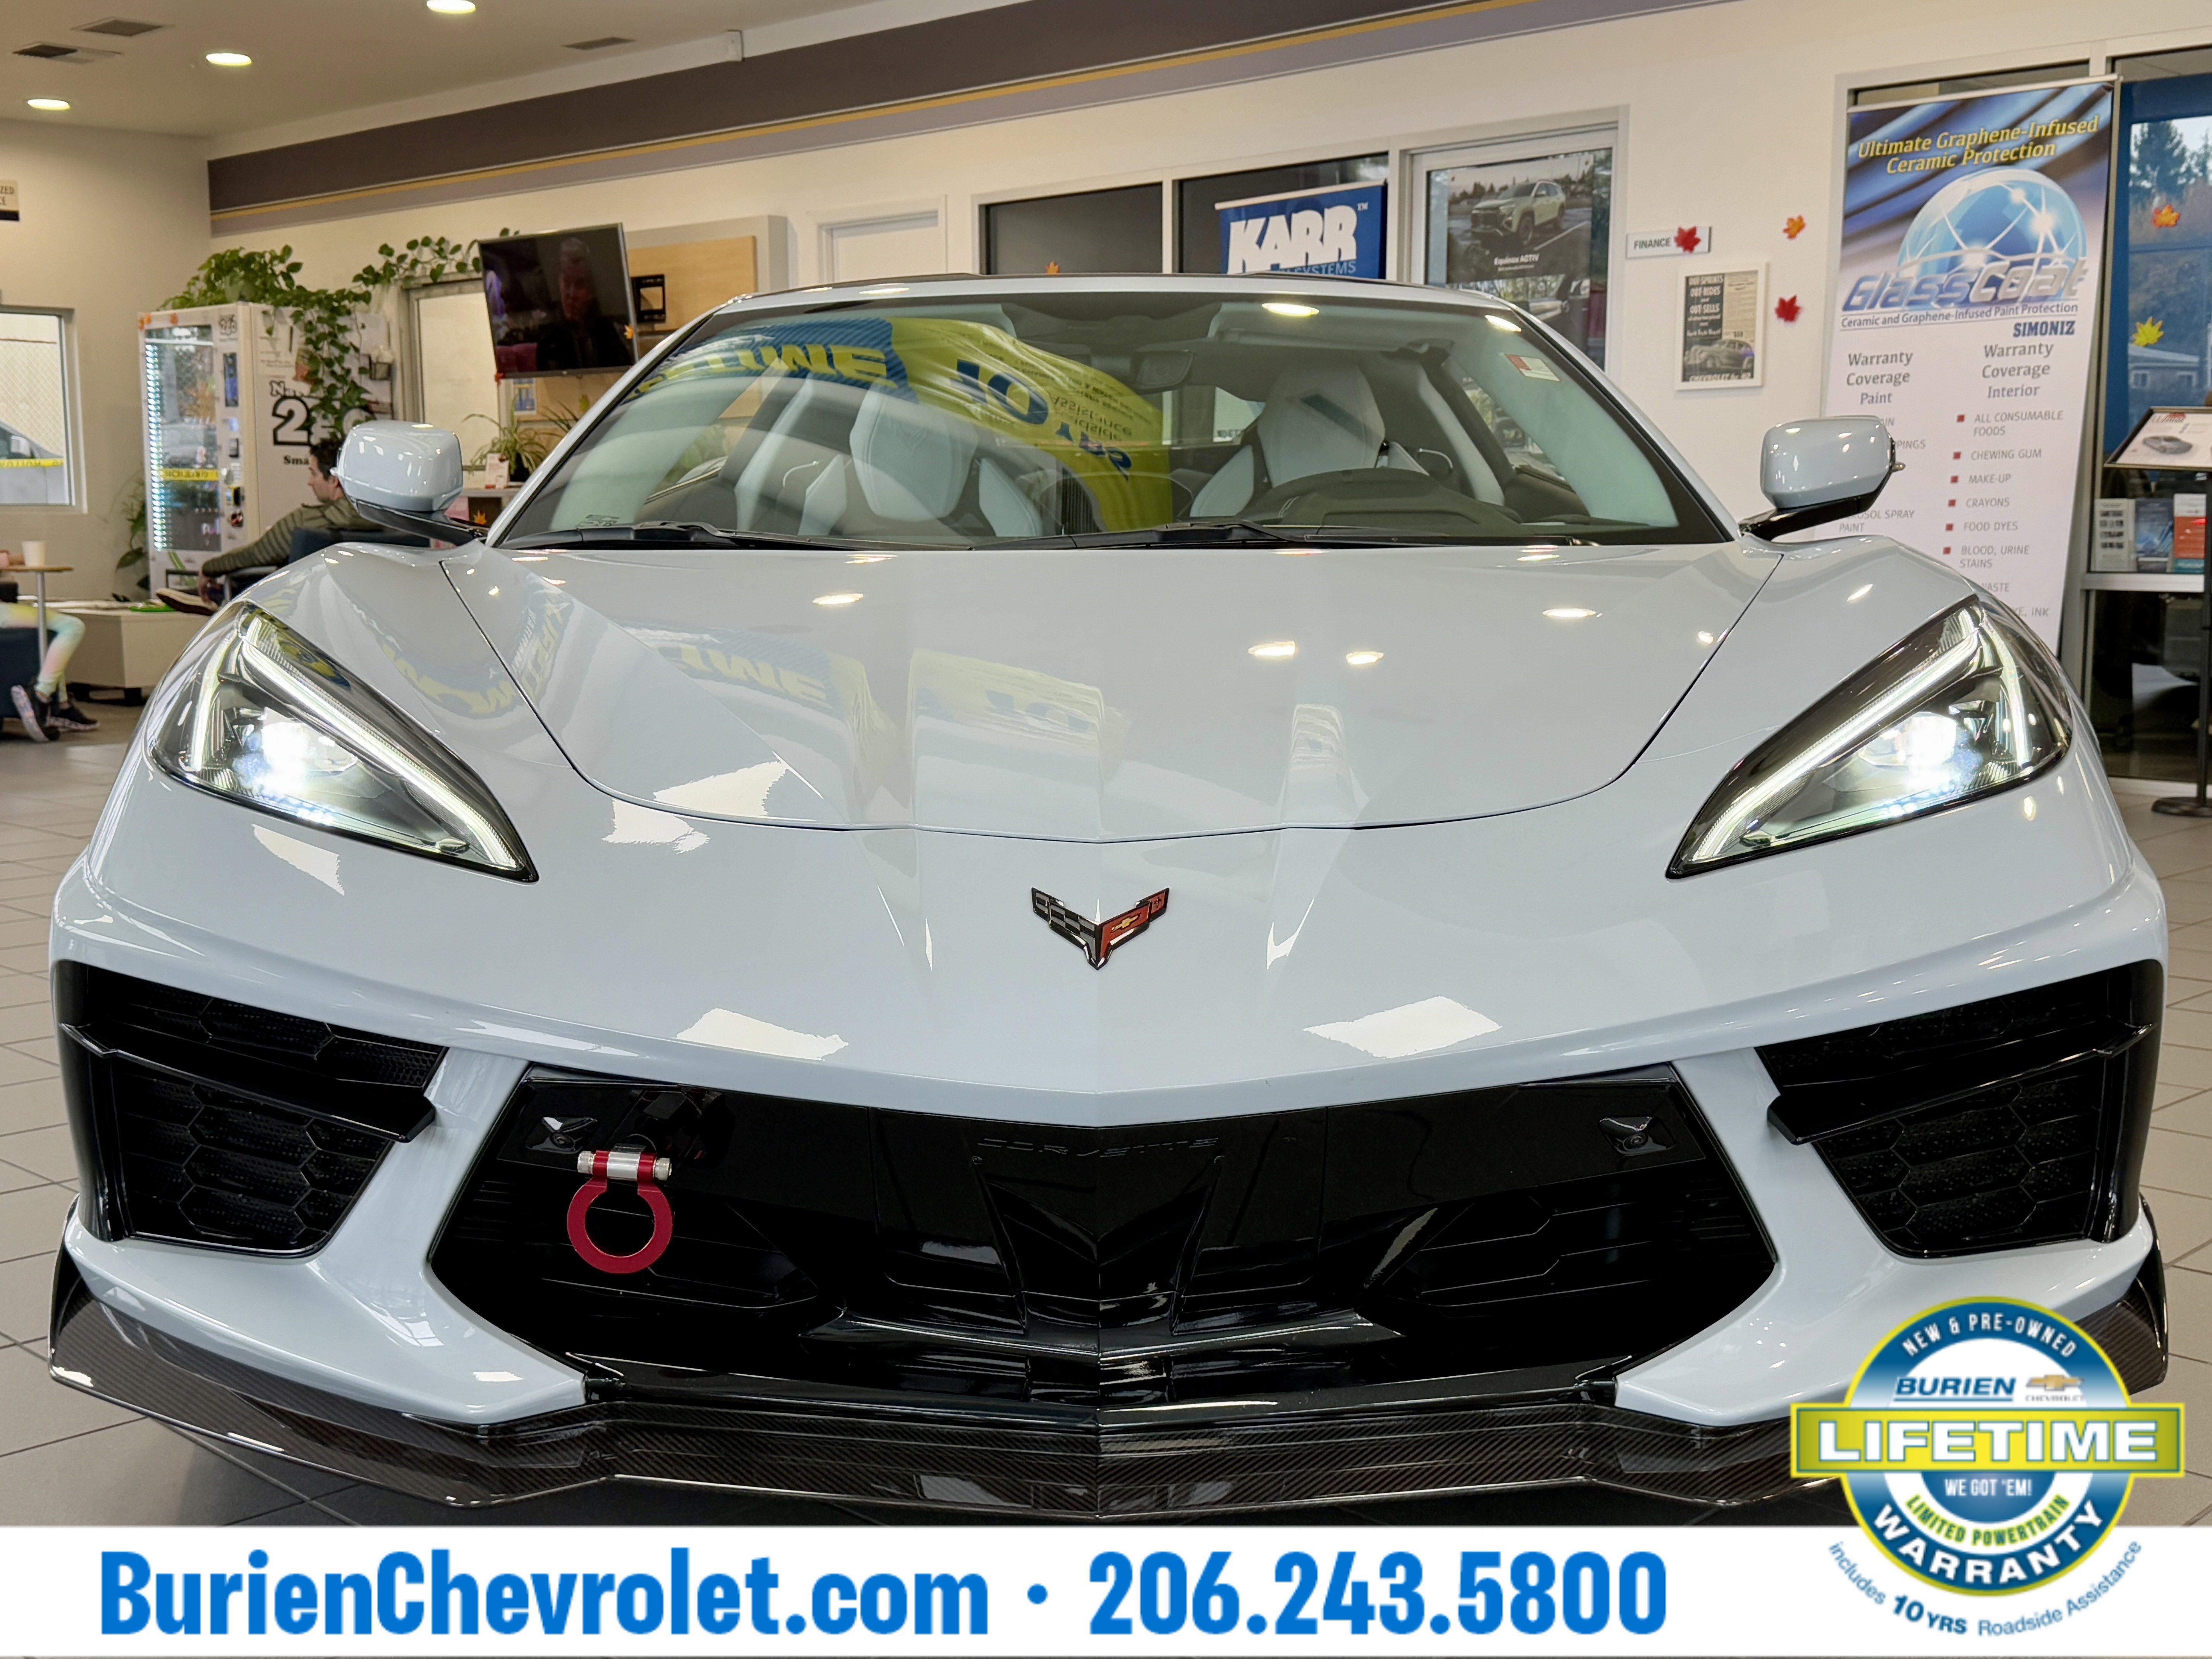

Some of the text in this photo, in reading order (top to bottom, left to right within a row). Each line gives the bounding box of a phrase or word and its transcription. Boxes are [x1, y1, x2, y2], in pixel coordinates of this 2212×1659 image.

[1859, 115, 2099, 158] Ultimate Graphene-Infused
[1887, 142, 2056, 174] Ceramic Protection
[1227, 205, 1356, 274] KARR
[1634, 237, 1671, 249] FINANCE
[1841, 303, 2078, 327] Ceramic and Graphene-Infused Paint Protection
[2013, 321, 2076, 338] SIMONIZ
[1984, 343, 2054, 358] Warranty
[1848, 352, 1913, 366] Warranty
[1982, 364, 2051, 379] Coverage
[1846, 372, 1910, 386] Coverage
[1987, 384, 2040, 398] Interior
[1860, 392, 1893, 404] Paint
[1975, 410, 2063, 423] ALL CONSUMABLE
[1973, 426, 2006, 436] FOODS
[1971, 448, 2042, 460] CHEWING GUM
[1968, 473, 2011, 484] MAKE-UP
[1966, 497, 2010, 508] CRAYONS
[1884, 509, 1915, 519] SPRAY
[1839, 522, 1865, 532] PAINT
[1963, 521, 2018, 532] FOOD DYES
[1961, 545, 2030, 556] BLOOD, URINE
[1960, 558, 1992, 568] STAINS
[2032, 607, 2049, 617] INK
